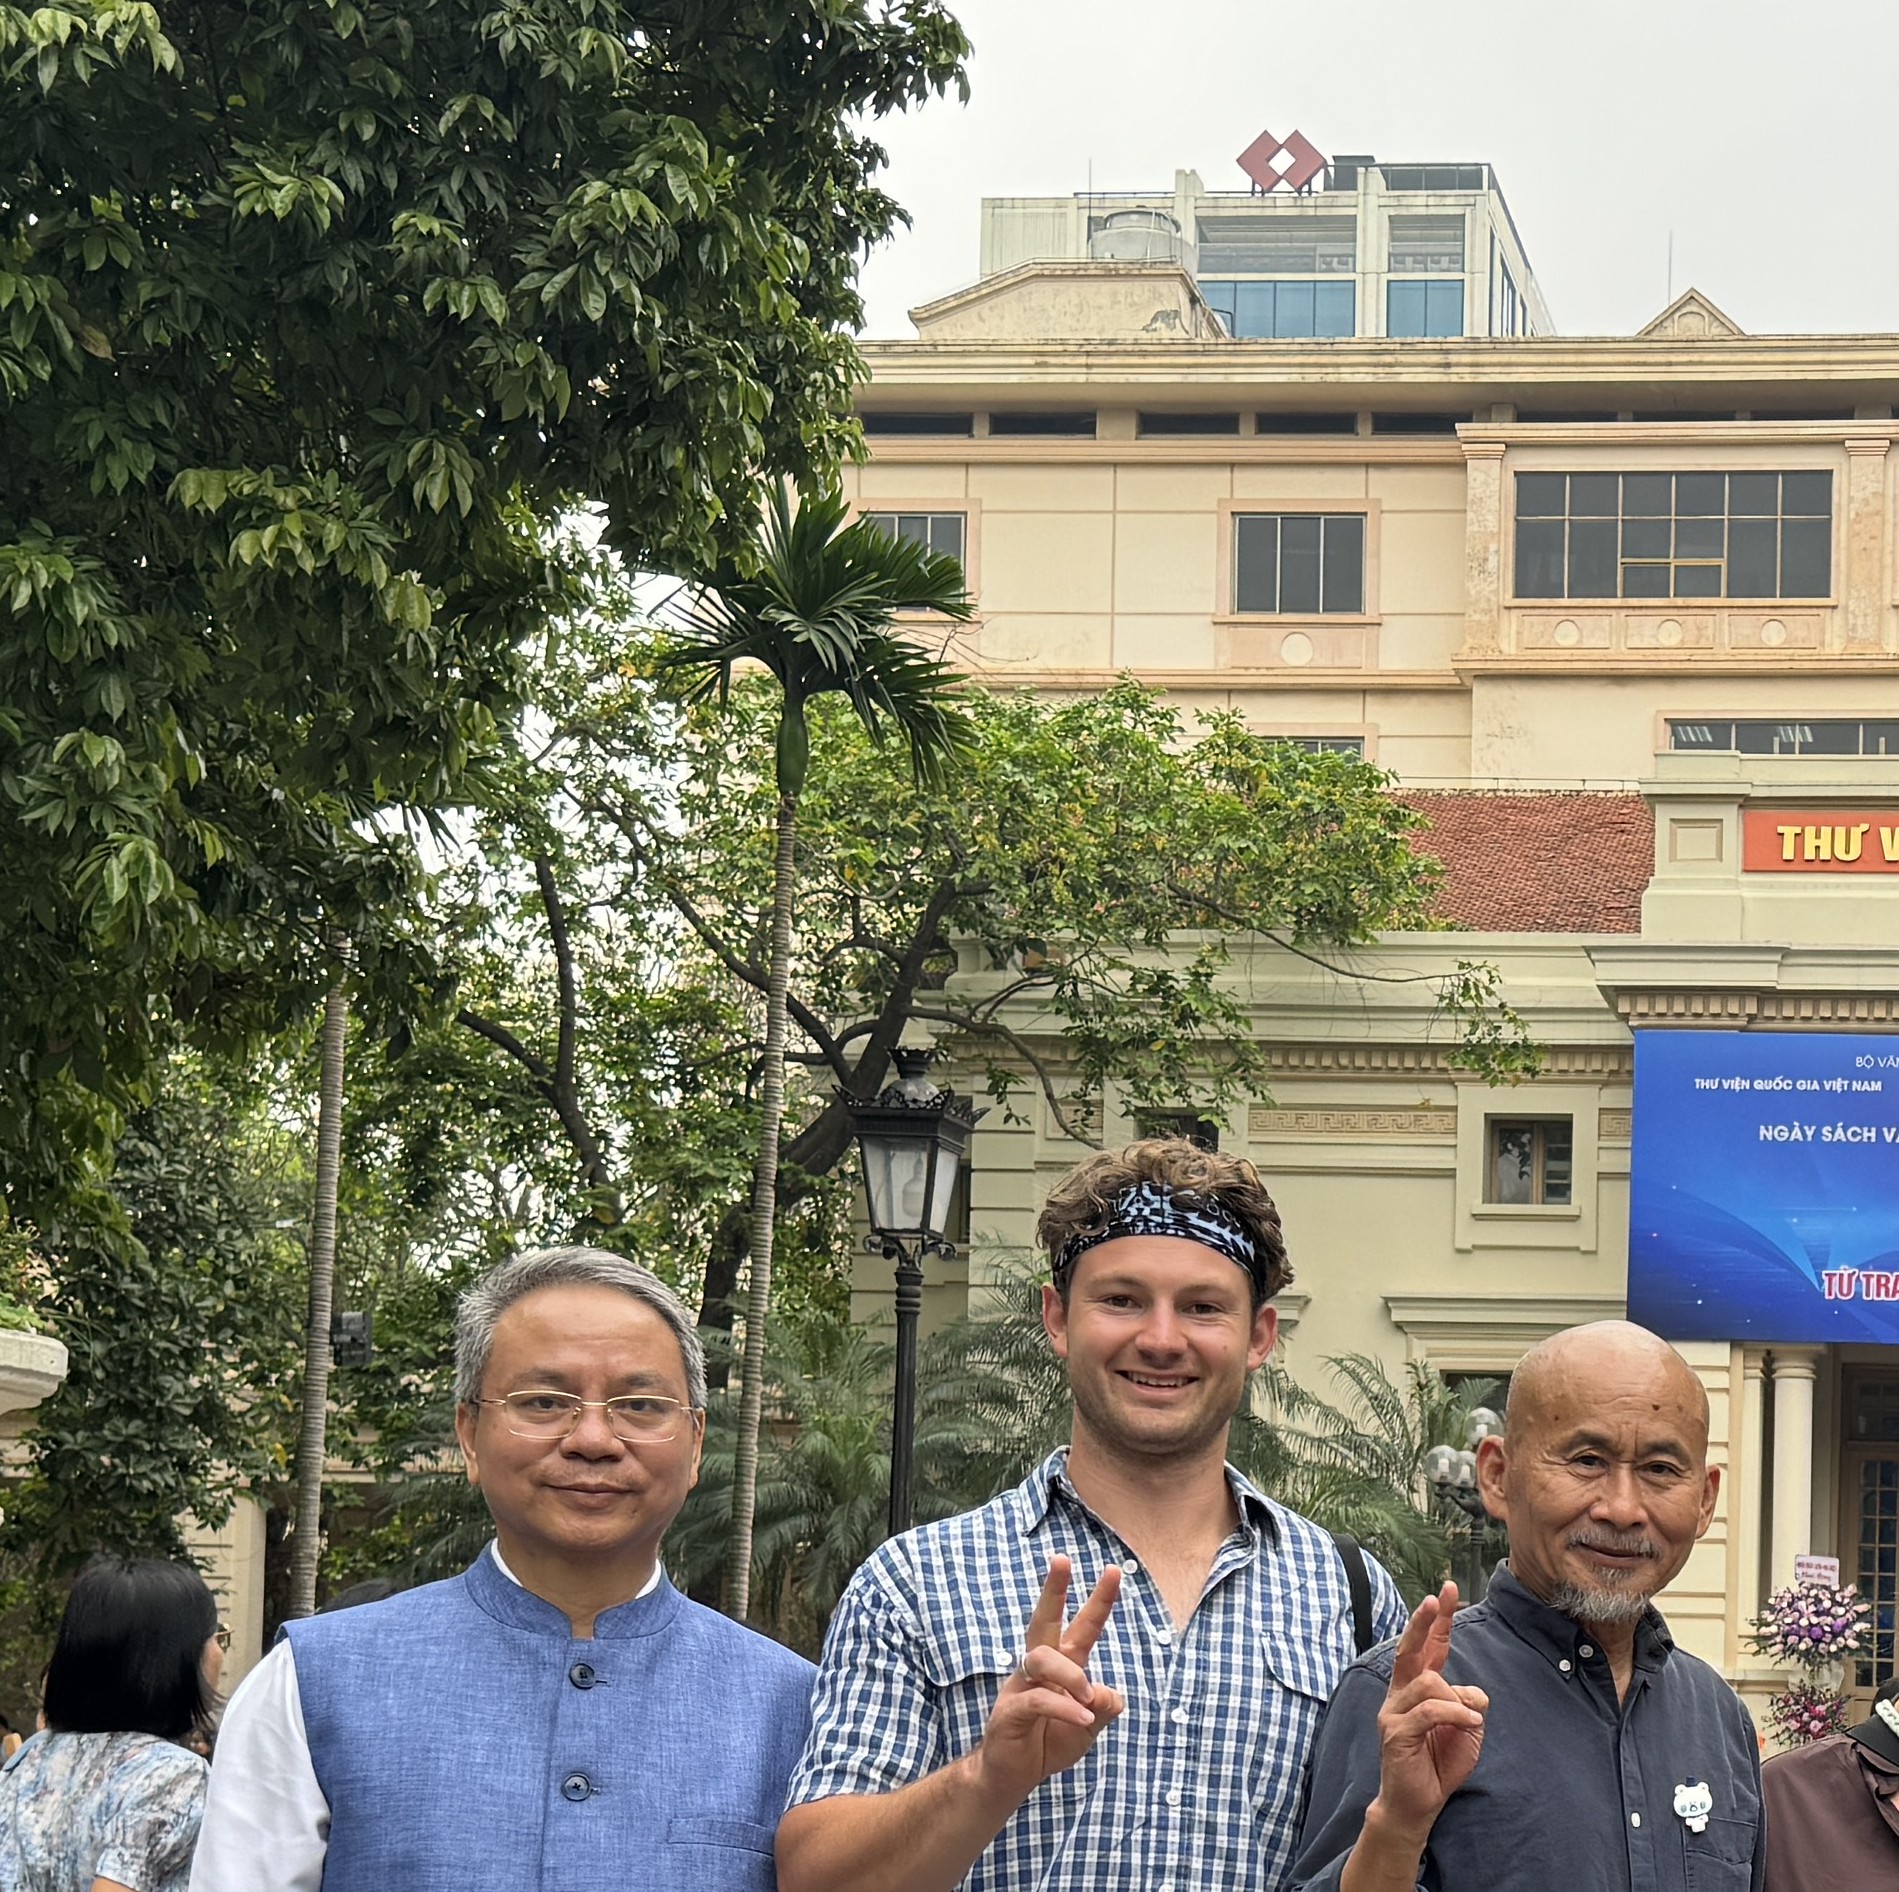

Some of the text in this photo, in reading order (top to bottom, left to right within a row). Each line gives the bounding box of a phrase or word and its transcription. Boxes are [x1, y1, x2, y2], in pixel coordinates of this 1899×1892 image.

[1776, 823, 1870, 862] THƯ
[1855, 1054, 1875, 1069] BỘ
[1694, 1075, 1882, 1094] THƯ VIỆN QUỐC GIA VIỆT NAM
[1759, 1121, 1817, 1142] NGÀY
[1821, 1121, 1877, 1143] SÁCH
[1822, 1264, 1858, 1299] TỪ
